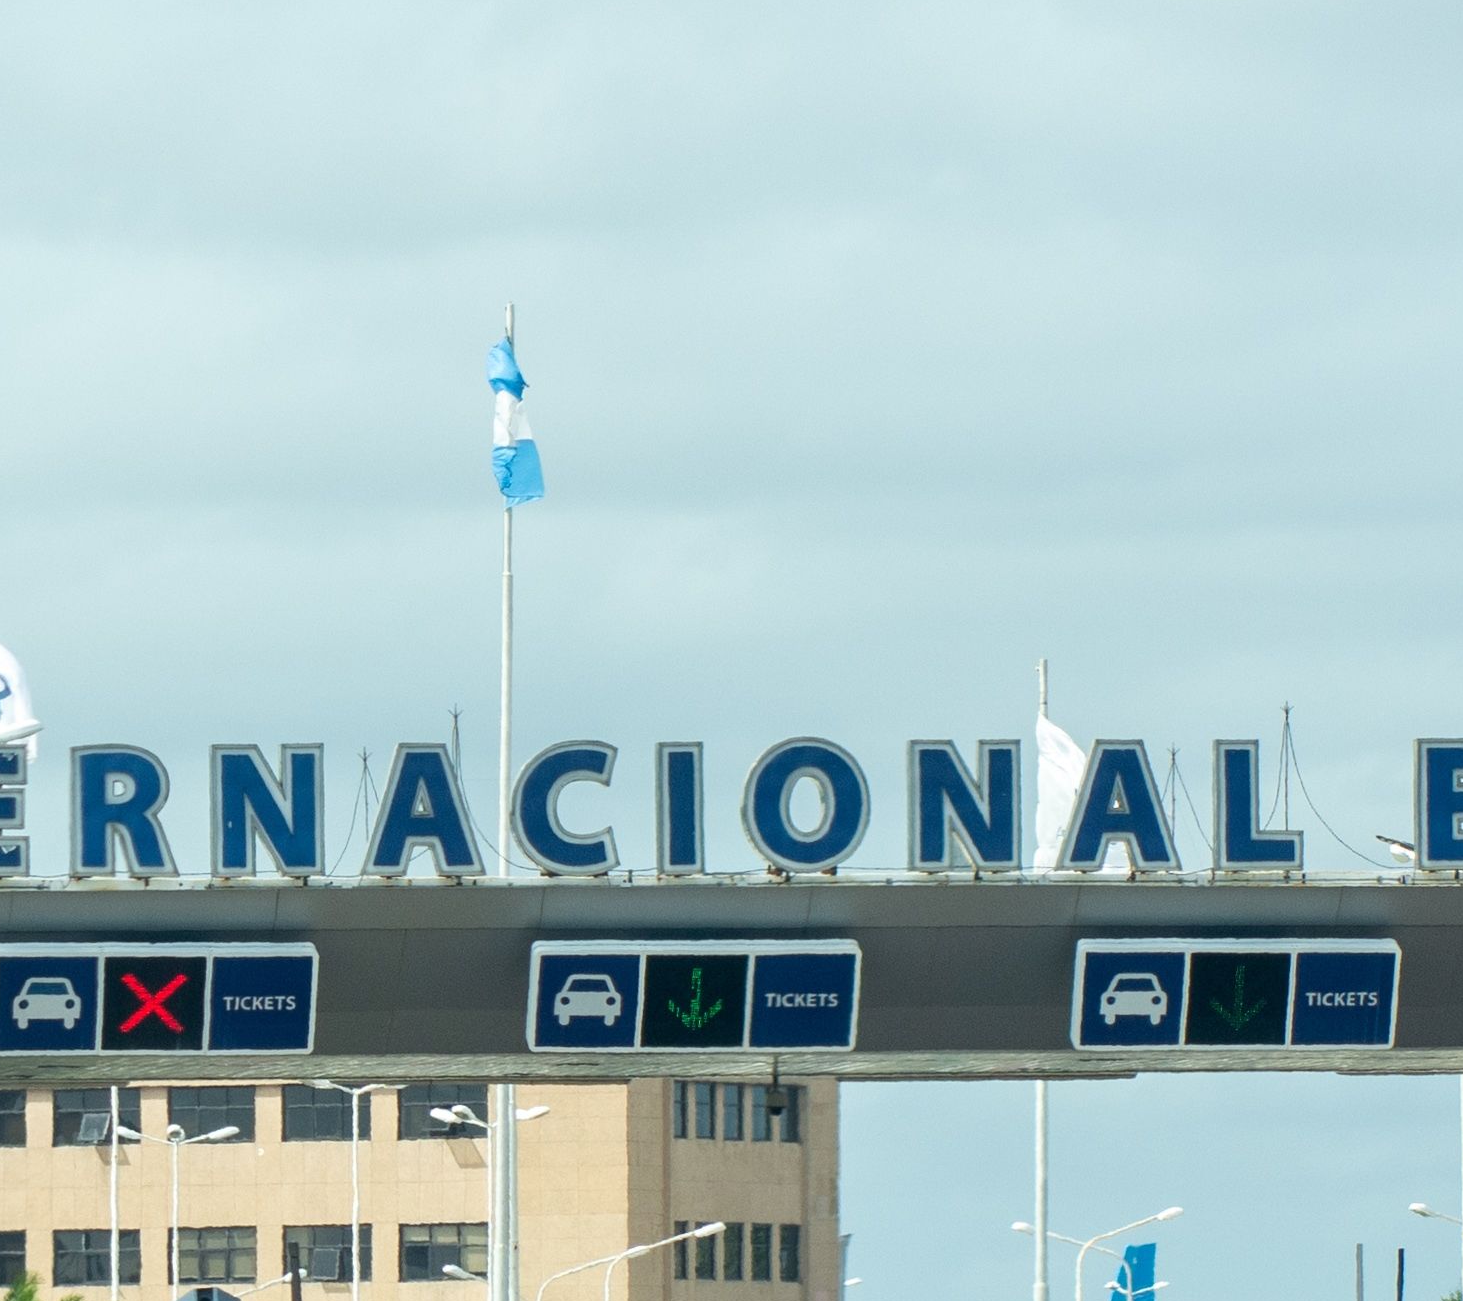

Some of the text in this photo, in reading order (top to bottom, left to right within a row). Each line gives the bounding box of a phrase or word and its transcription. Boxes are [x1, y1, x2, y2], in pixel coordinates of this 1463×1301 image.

[224, 997, 296, 1010] TICKETS
[765, 994, 838, 1007] TICKETS
[1306, 993, 1378, 1006] TICKETS
